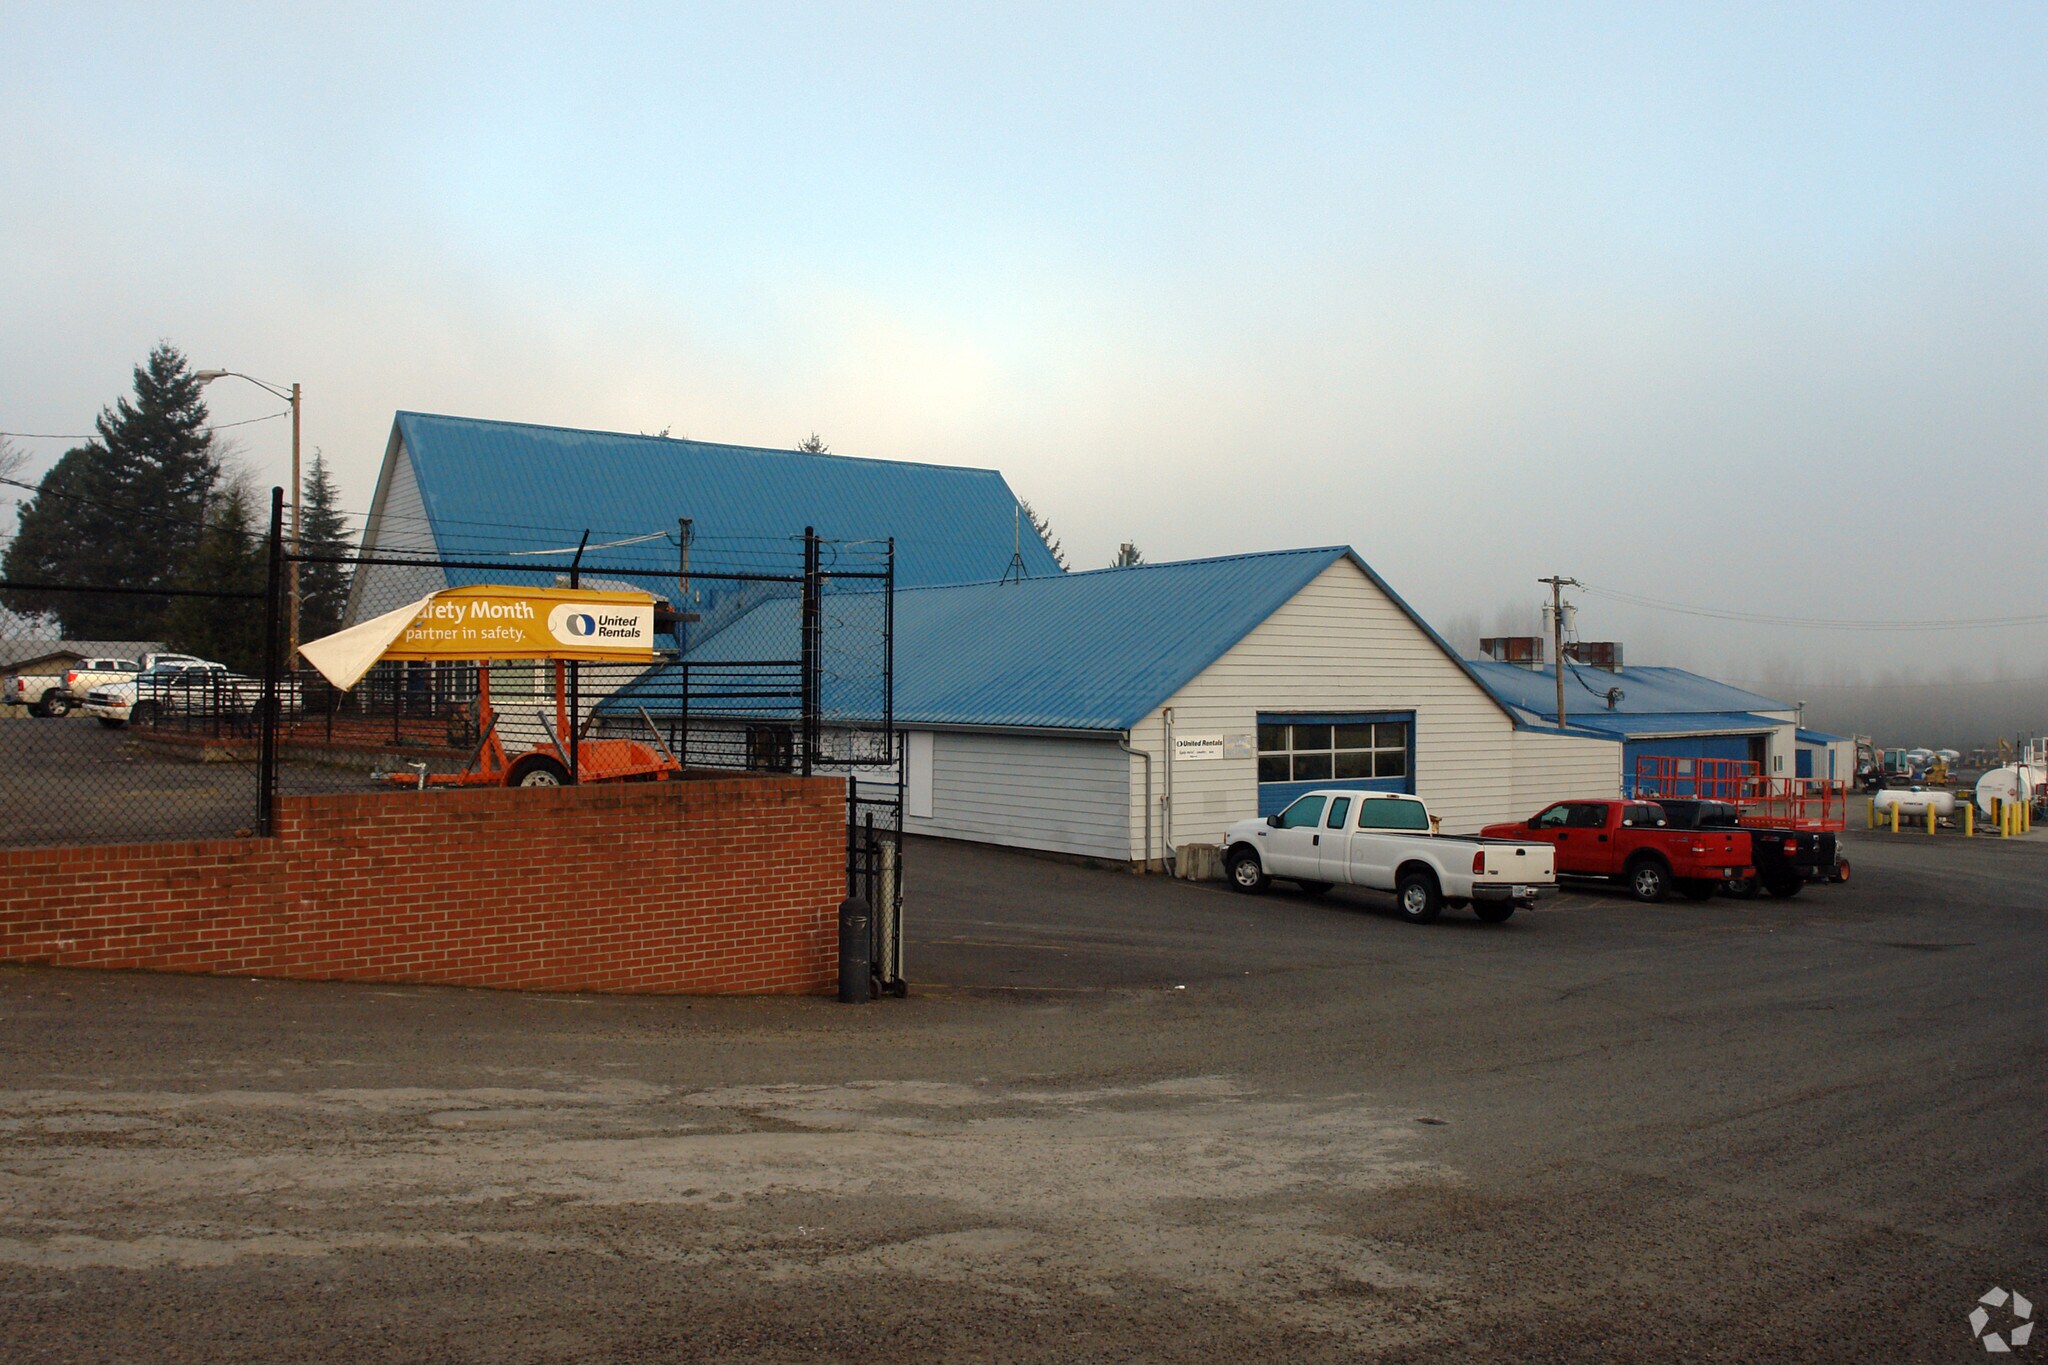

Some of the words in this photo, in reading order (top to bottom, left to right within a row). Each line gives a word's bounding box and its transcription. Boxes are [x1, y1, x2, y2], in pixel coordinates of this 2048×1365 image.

[470, 601, 534, 618] Month
[598, 615, 638, 626] United
[406, 627, 458, 642] partner
[462, 626, 476, 639] in
[481, 625, 526, 642] safety.
[598, 627, 641, 638] Rentals
